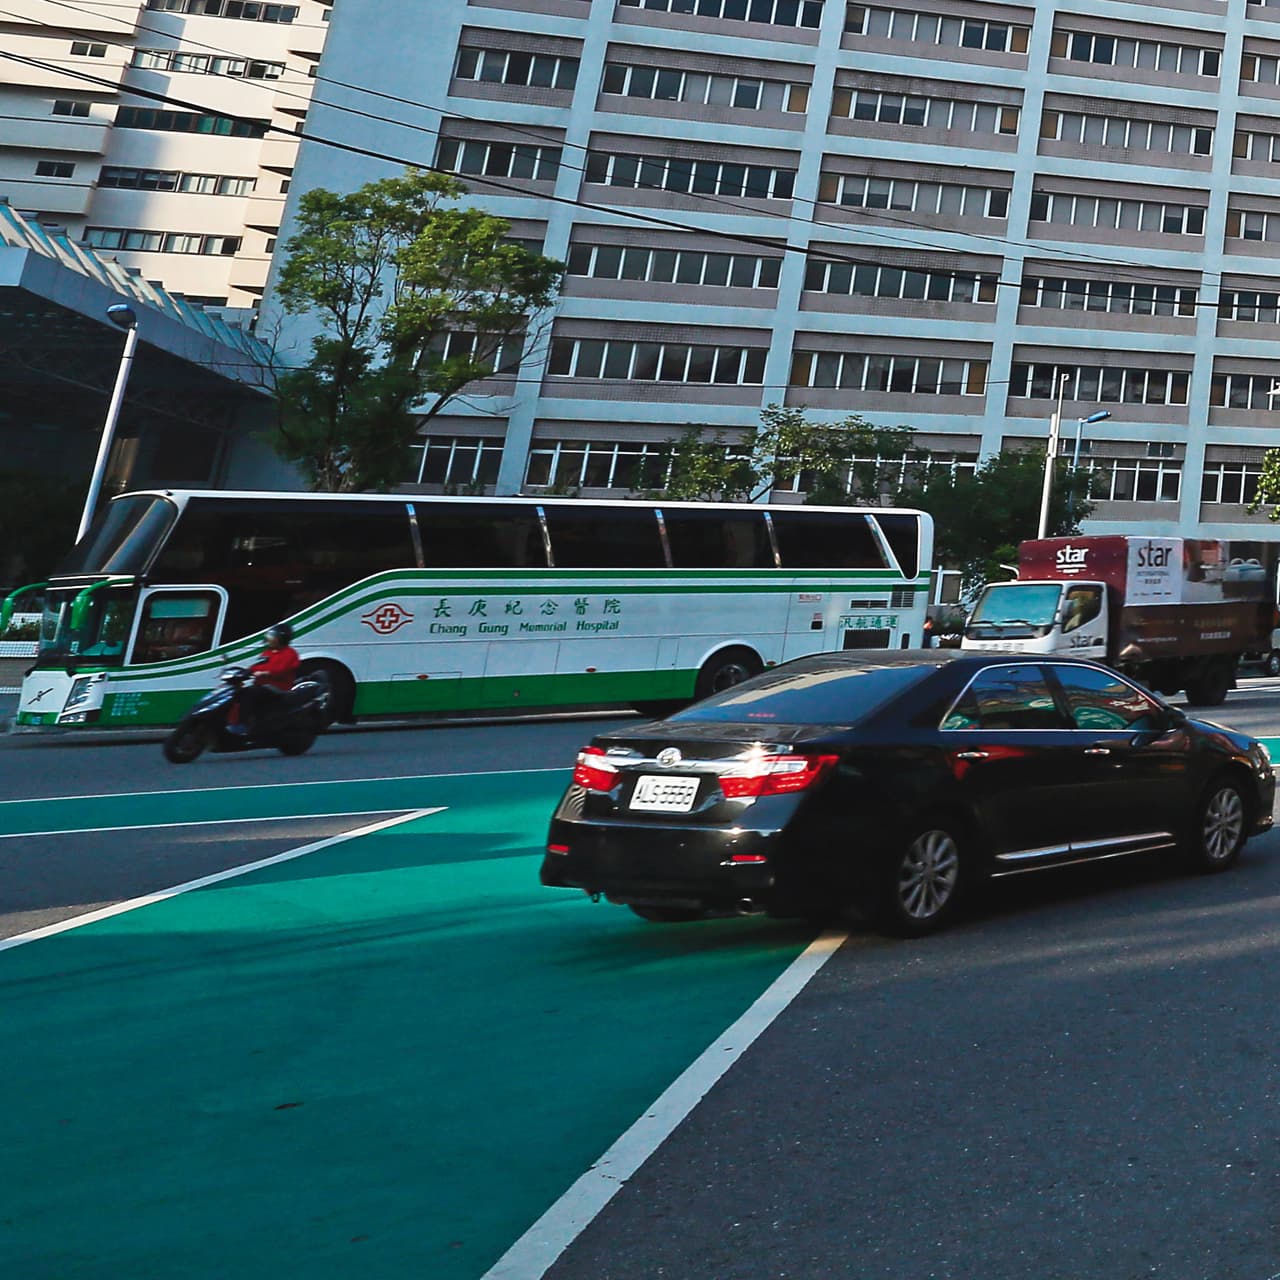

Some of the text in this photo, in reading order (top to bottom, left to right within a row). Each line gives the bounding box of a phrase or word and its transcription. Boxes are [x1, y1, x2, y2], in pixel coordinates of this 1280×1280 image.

[1056, 545, 1089, 564] star
[1138, 540, 1173, 567] star
[433, 598, 621, 618] 長庚紀念醫院
[429, 620, 619, 636] Chang Gung Memorial Hospital
